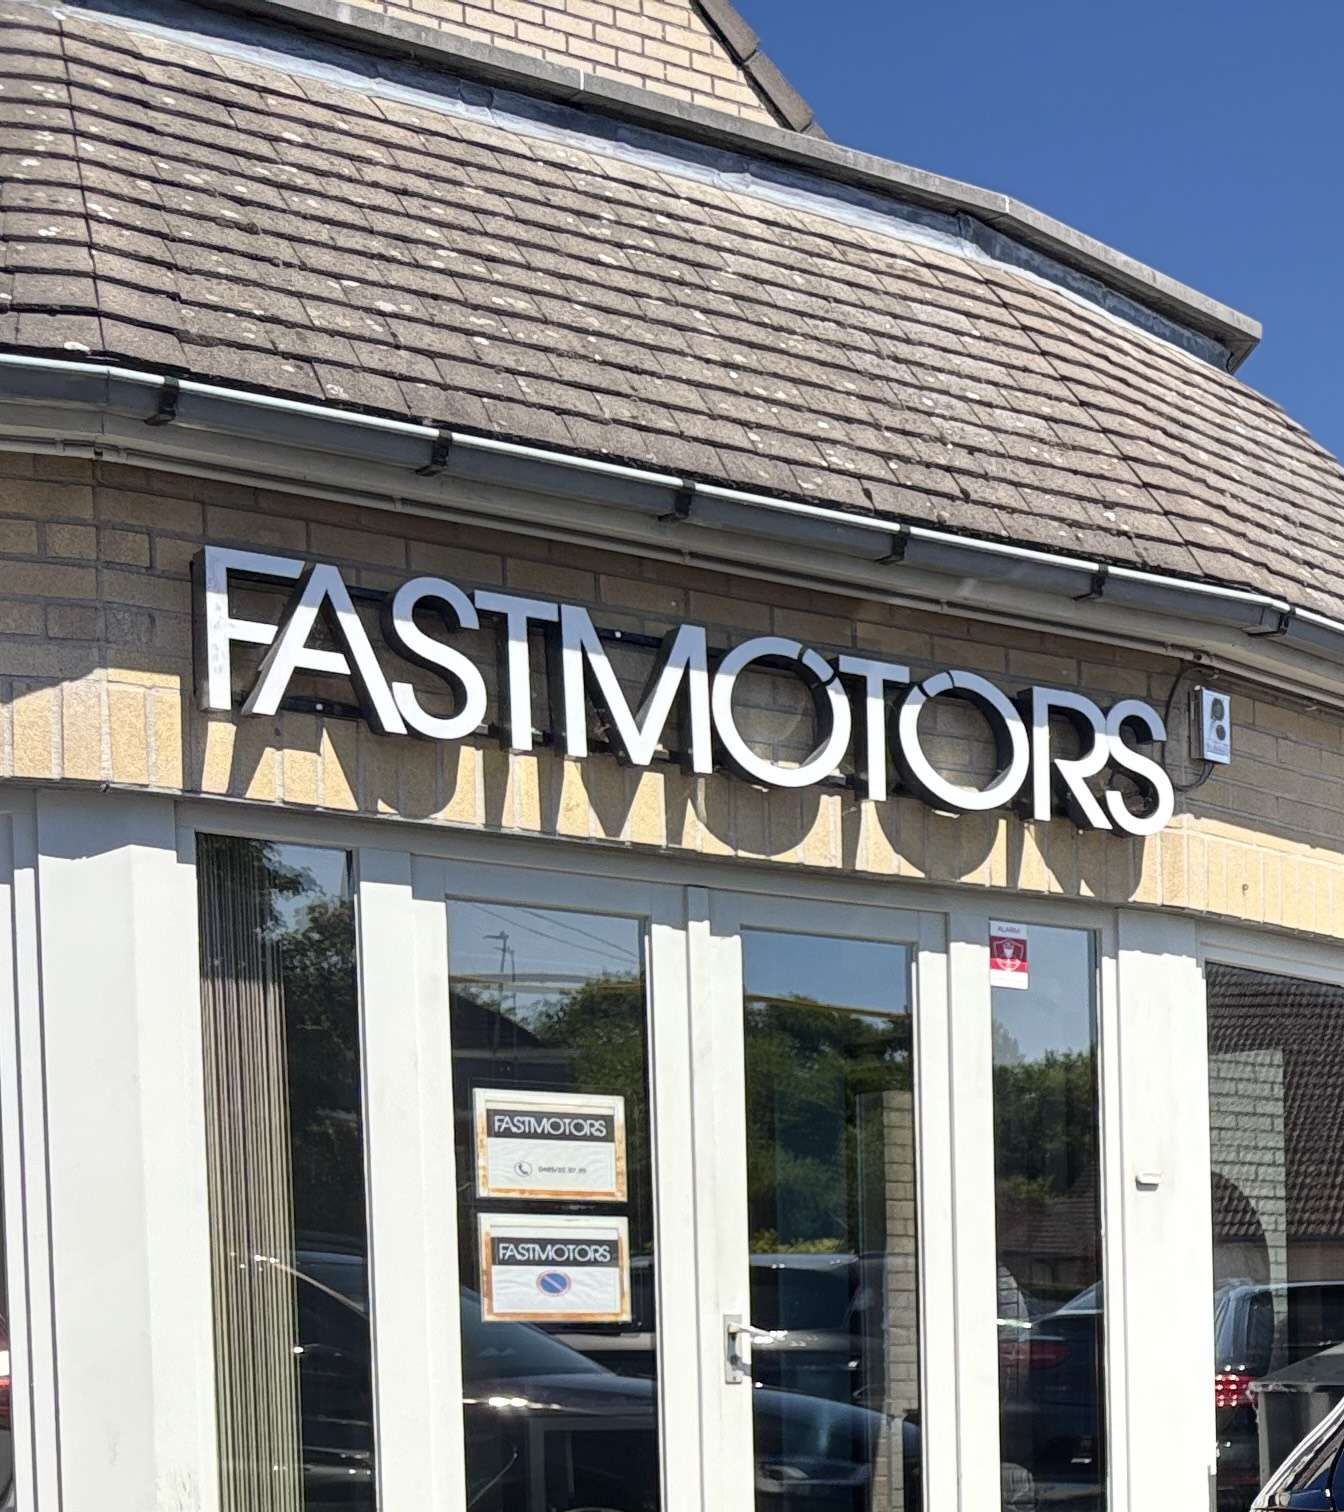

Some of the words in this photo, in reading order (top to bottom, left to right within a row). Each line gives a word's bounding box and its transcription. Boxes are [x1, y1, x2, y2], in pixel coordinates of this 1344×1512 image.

[204, 545, 1174, 837] FASTMOTORS
[494, 1115, 607, 1137] FASTMOTORS
[499, 1243, 611, 1262] FASTMOTORS
